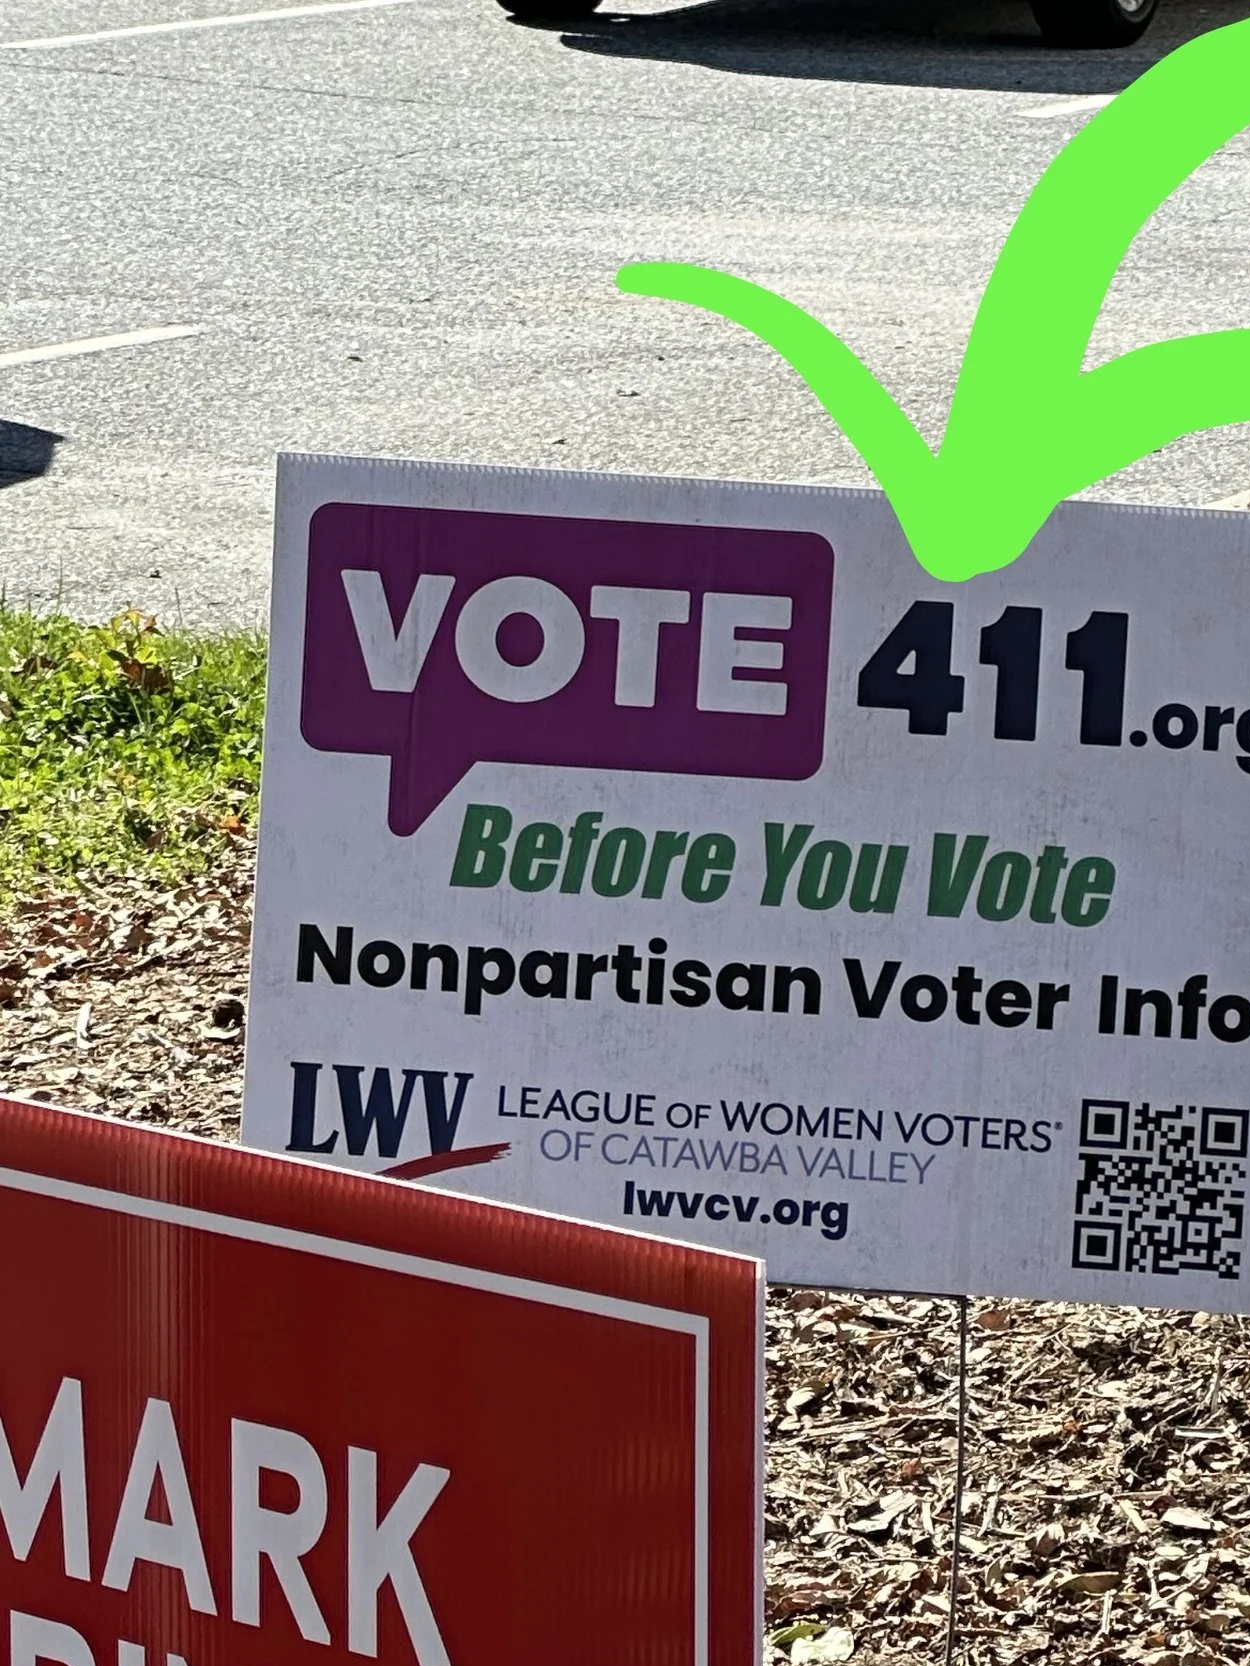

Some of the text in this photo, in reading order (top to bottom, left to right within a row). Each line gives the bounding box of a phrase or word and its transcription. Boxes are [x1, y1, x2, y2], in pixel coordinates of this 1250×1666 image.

[341, 569, 793, 716] VOTE
[449, 803, 1117, 928] Before You Vote
[296, 923, 821, 1015] Nonpartisan
[843, 958, 1070, 1030] Voter
[285, 1061, 475, 1159] LWV
[497, 1085, 656, 1127] LEAGUE
[666, 1103, 711, 1130] OF
[720, 1100, 883, 1142] WOMEN
[540, 1129, 936, 1185] OF CATAWBA VALLEY
[624, 1180, 849, 1240] lwvcv.org
